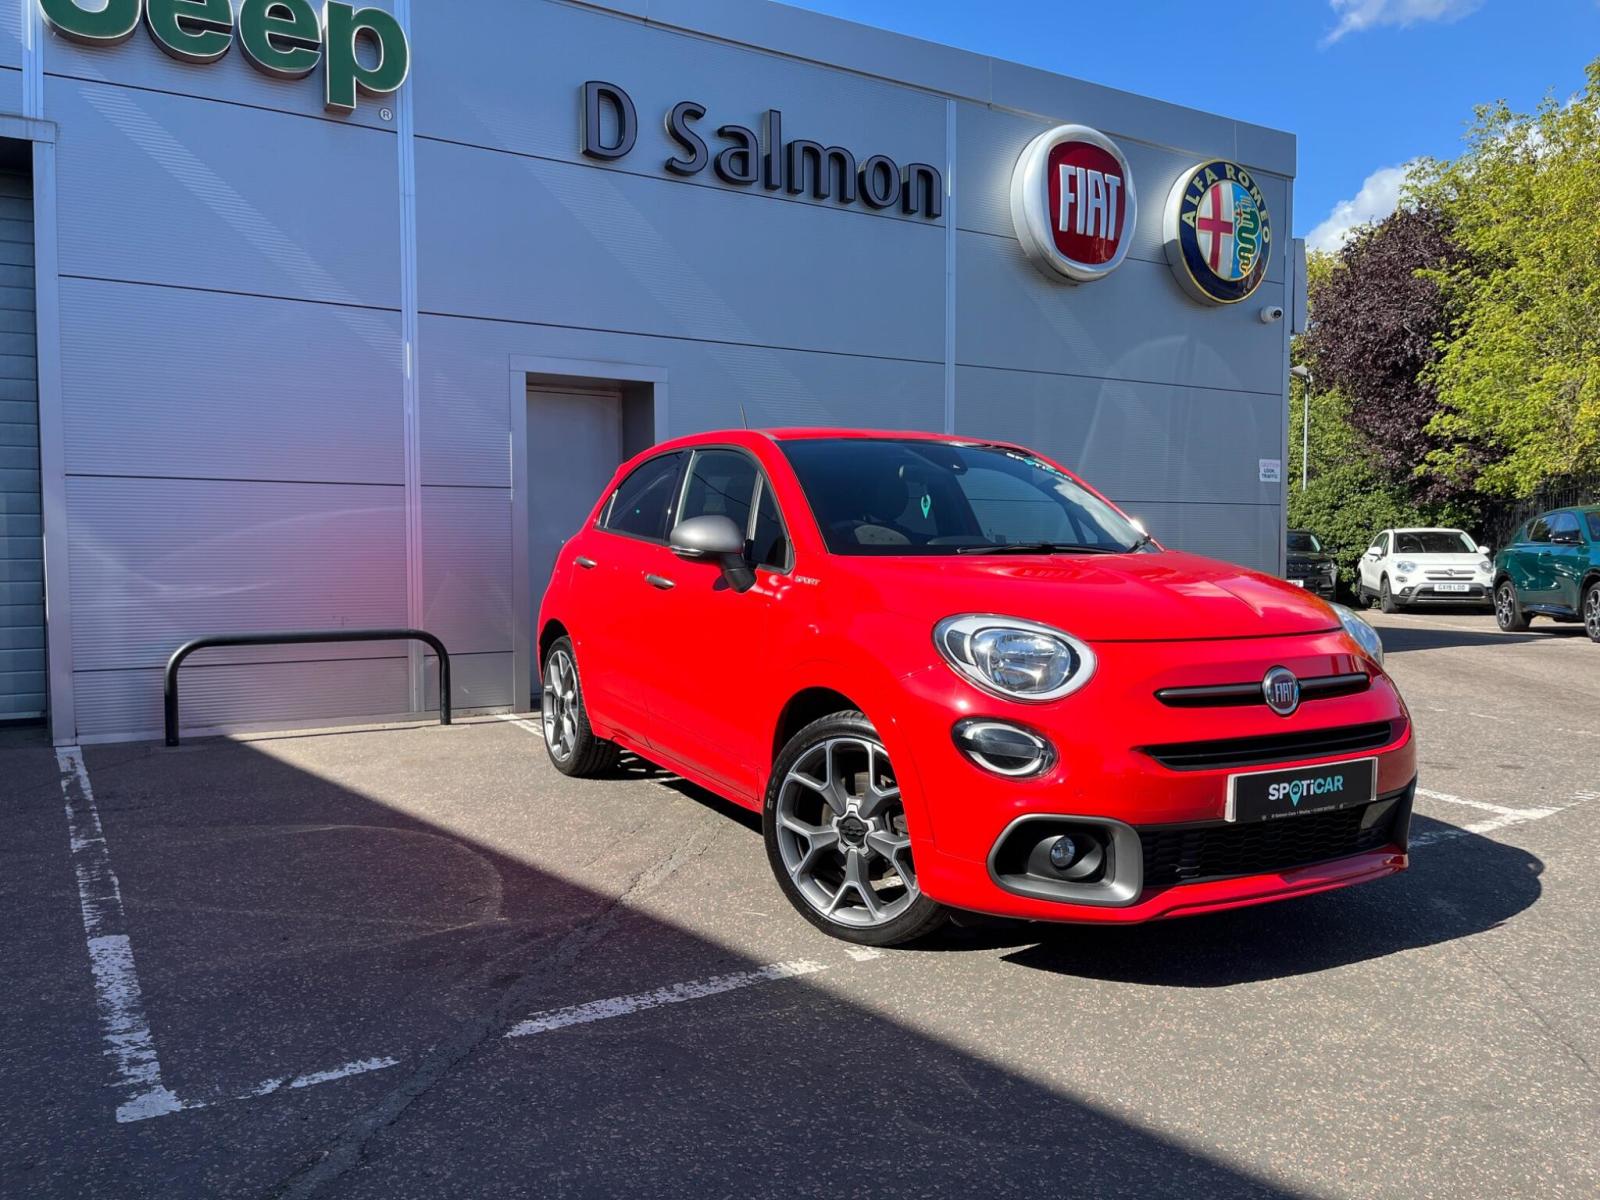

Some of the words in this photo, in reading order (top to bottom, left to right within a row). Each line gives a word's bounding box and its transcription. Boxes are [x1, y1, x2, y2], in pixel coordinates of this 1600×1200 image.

[580, 80, 637, 161] D
[664, 101, 942, 219] Salmon
[1059, 164, 1121, 241] FIAT
[1181, 168, 1219, 229] ALFA
[1224, 164, 1270, 243] ROMEO
[1274, 682, 1293, 703] FIAT
